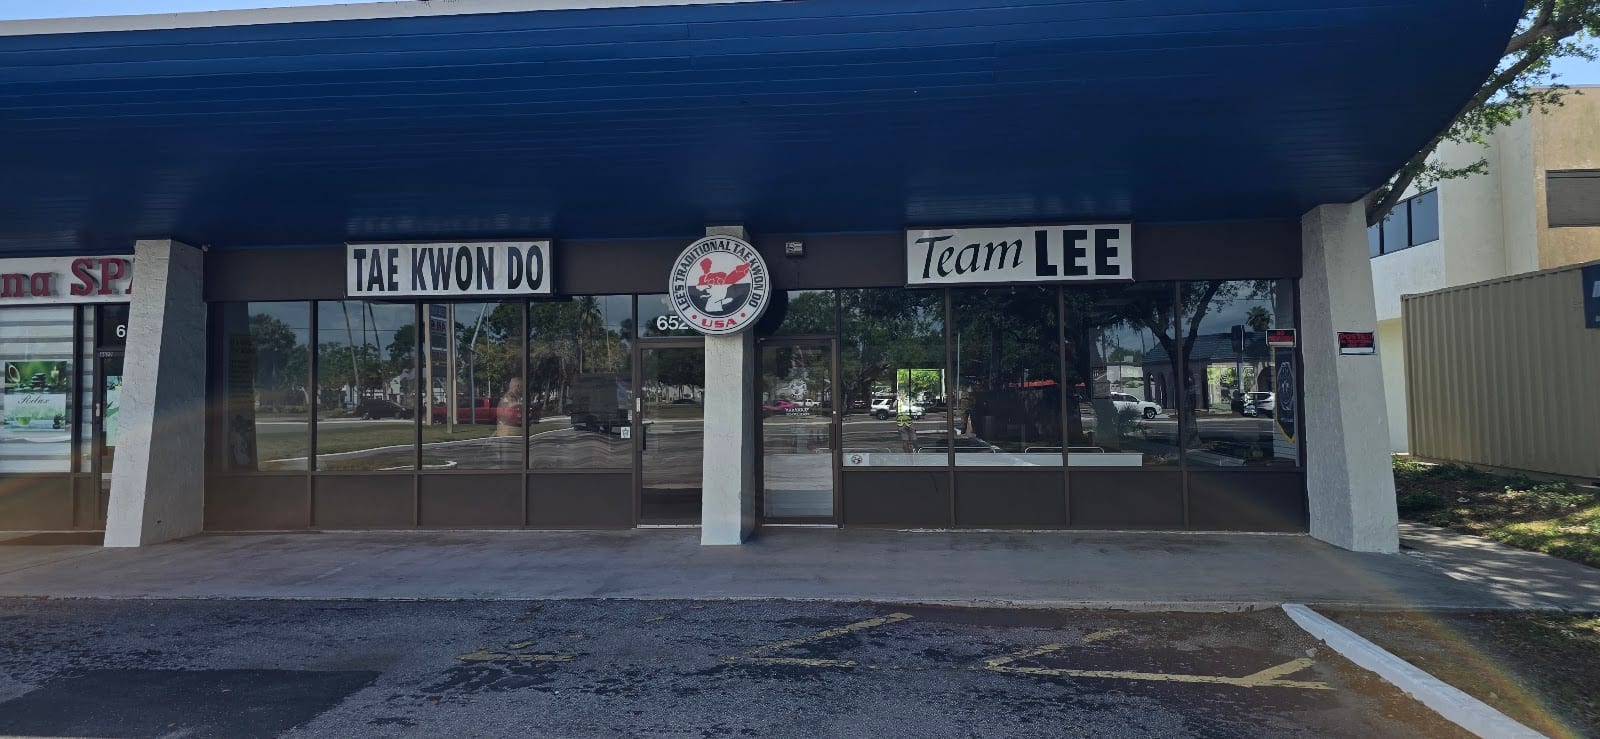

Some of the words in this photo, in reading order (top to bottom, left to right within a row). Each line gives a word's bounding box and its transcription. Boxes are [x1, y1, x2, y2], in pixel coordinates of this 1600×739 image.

[353, 248, 399, 292] TAE
[411, 245, 494, 291] KWON
[507, 245, 544, 290] DO
[914, 234, 1023, 279] Team
[1035, 228, 1120, 277] LEE
[70, 257, 133, 296] SP
[674, 240, 732, 282] TRADITIONAL
[732, 243, 753, 262] TAE
[748, 293, 762, 308] DO
[656, 315, 693, 331] 652
[701, 318, 737, 328] USA
[17, 394, 50, 405] Relax
